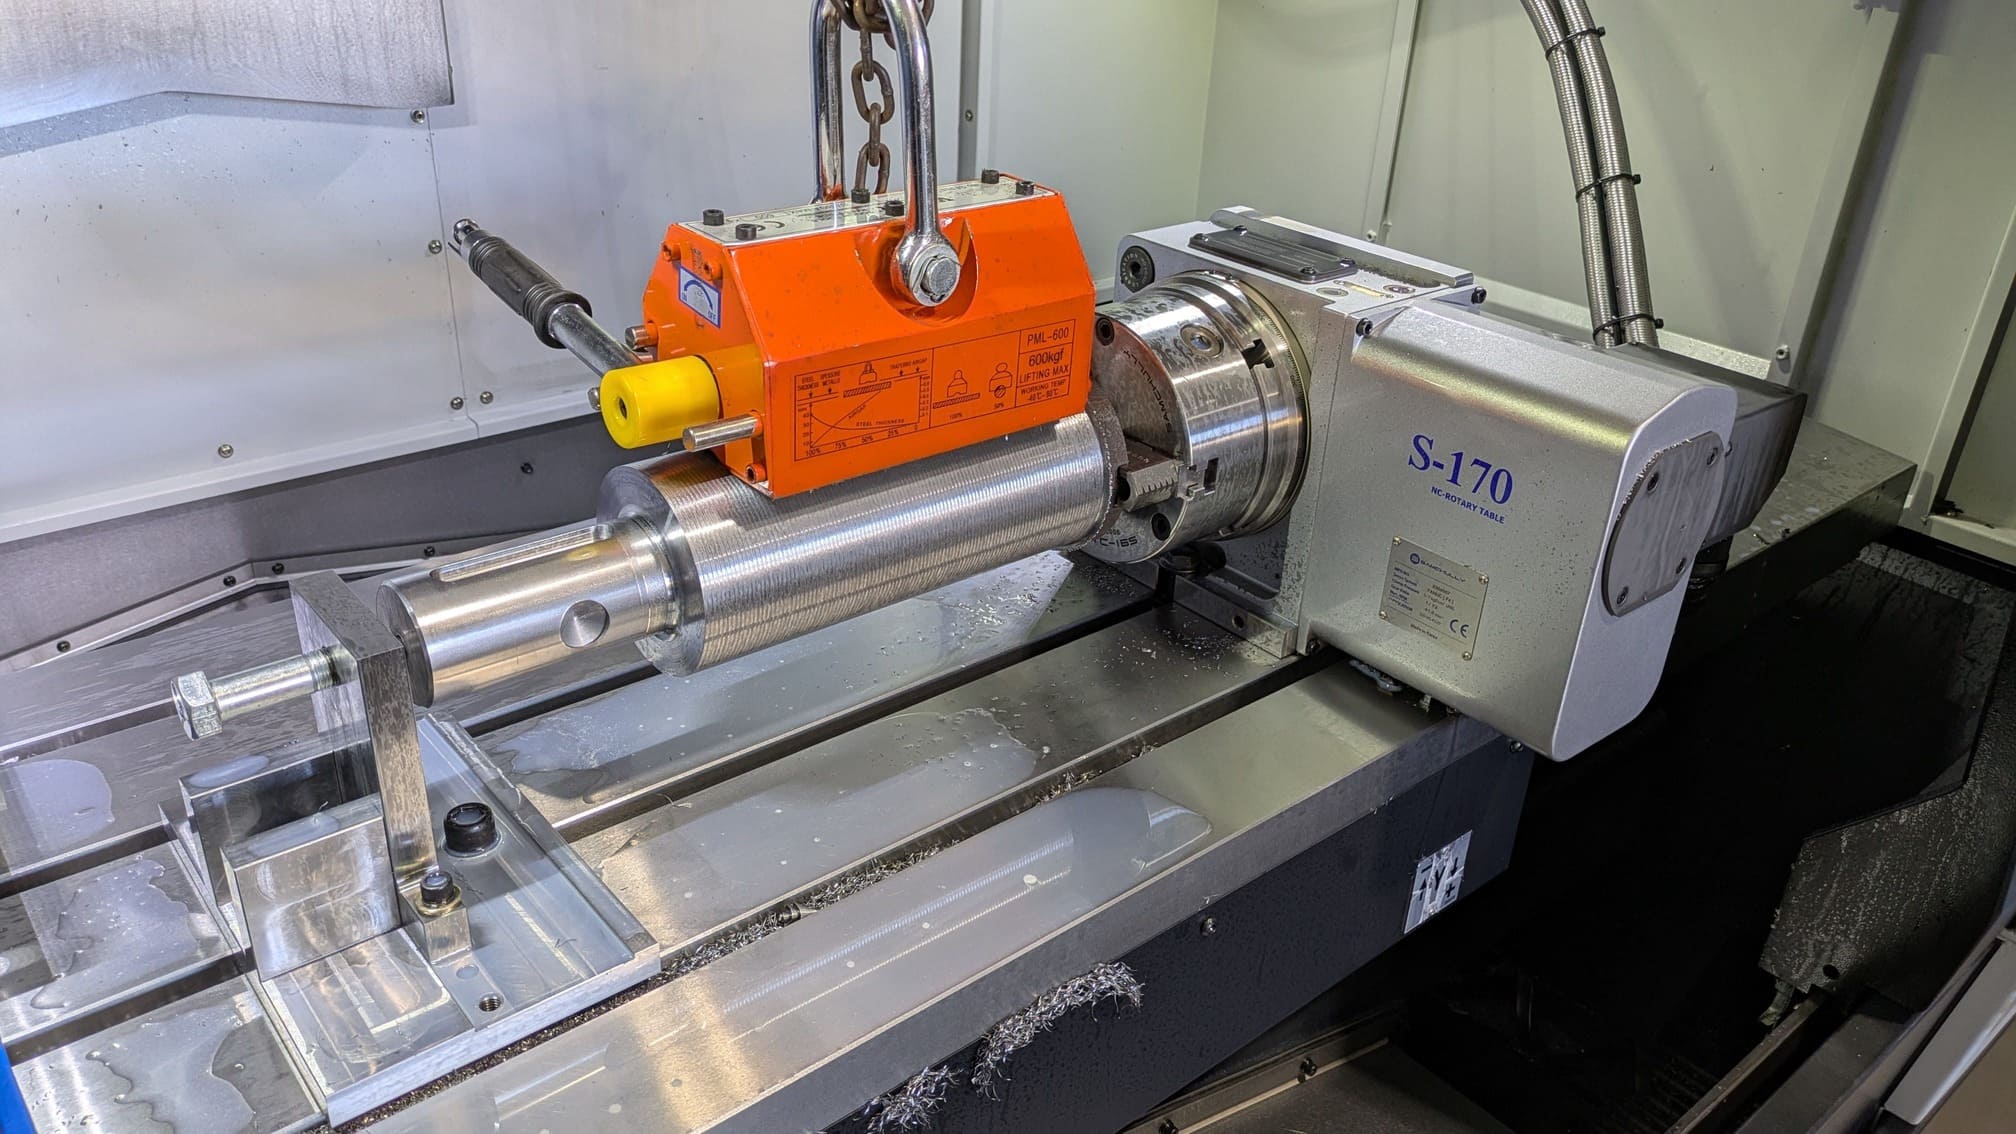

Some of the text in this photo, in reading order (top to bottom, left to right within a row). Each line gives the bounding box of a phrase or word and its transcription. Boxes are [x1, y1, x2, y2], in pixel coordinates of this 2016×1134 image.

[1027, 326, 1069, 346] PML-600
[1028, 347, 1064, 367] 600kgf
[1019, 364, 1069, 384] LIFTING MAX
[1020, 379, 1066, 395] WORKING TEMP
[806, 447, 821, 456] 100%
[1408, 434, 1513, 505] S-170
[1431, 486, 1506, 525] NC-ROTARY TABLE
